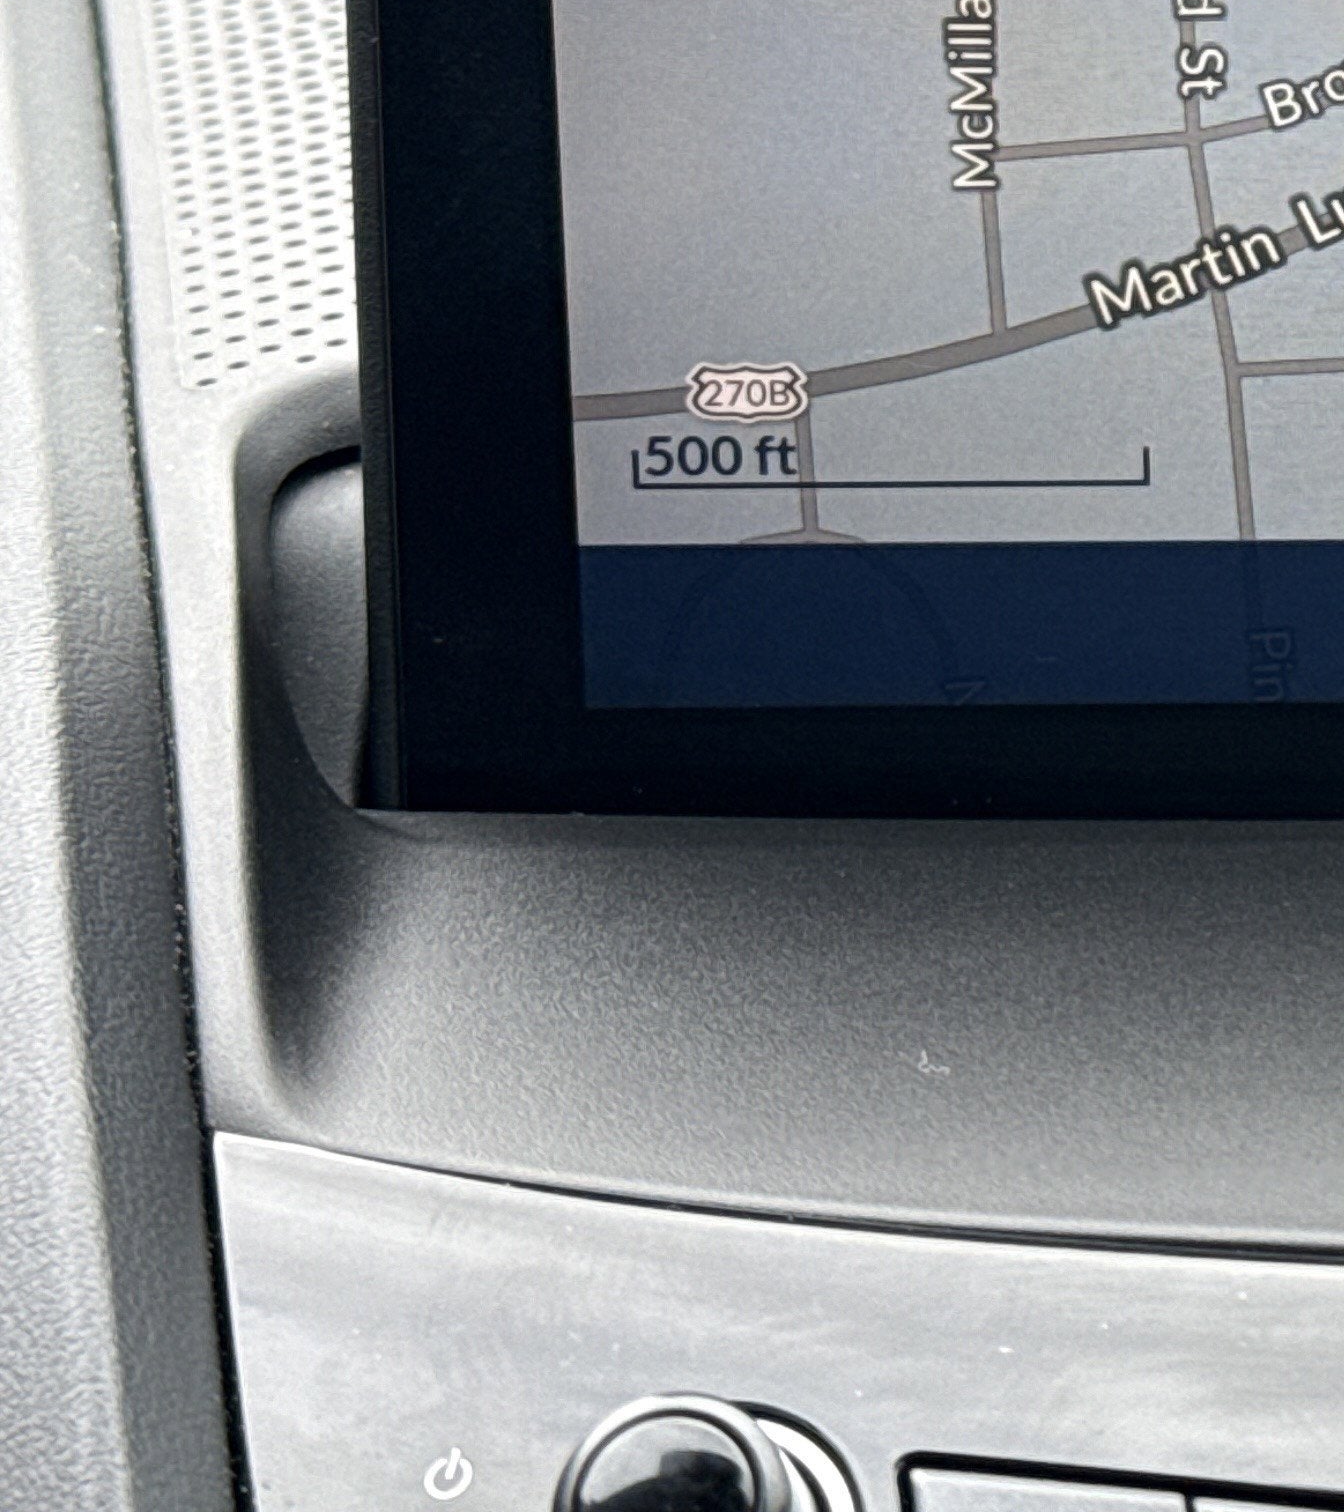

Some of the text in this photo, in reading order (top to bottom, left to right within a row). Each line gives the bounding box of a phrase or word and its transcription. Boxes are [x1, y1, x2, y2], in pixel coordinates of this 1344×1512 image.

[1180, 47, 1223, 96] St
[1091, 230, 1280, 325] Martin
[704, 379, 791, 408] 270B
[645, 435, 797, 475] 500 ft
